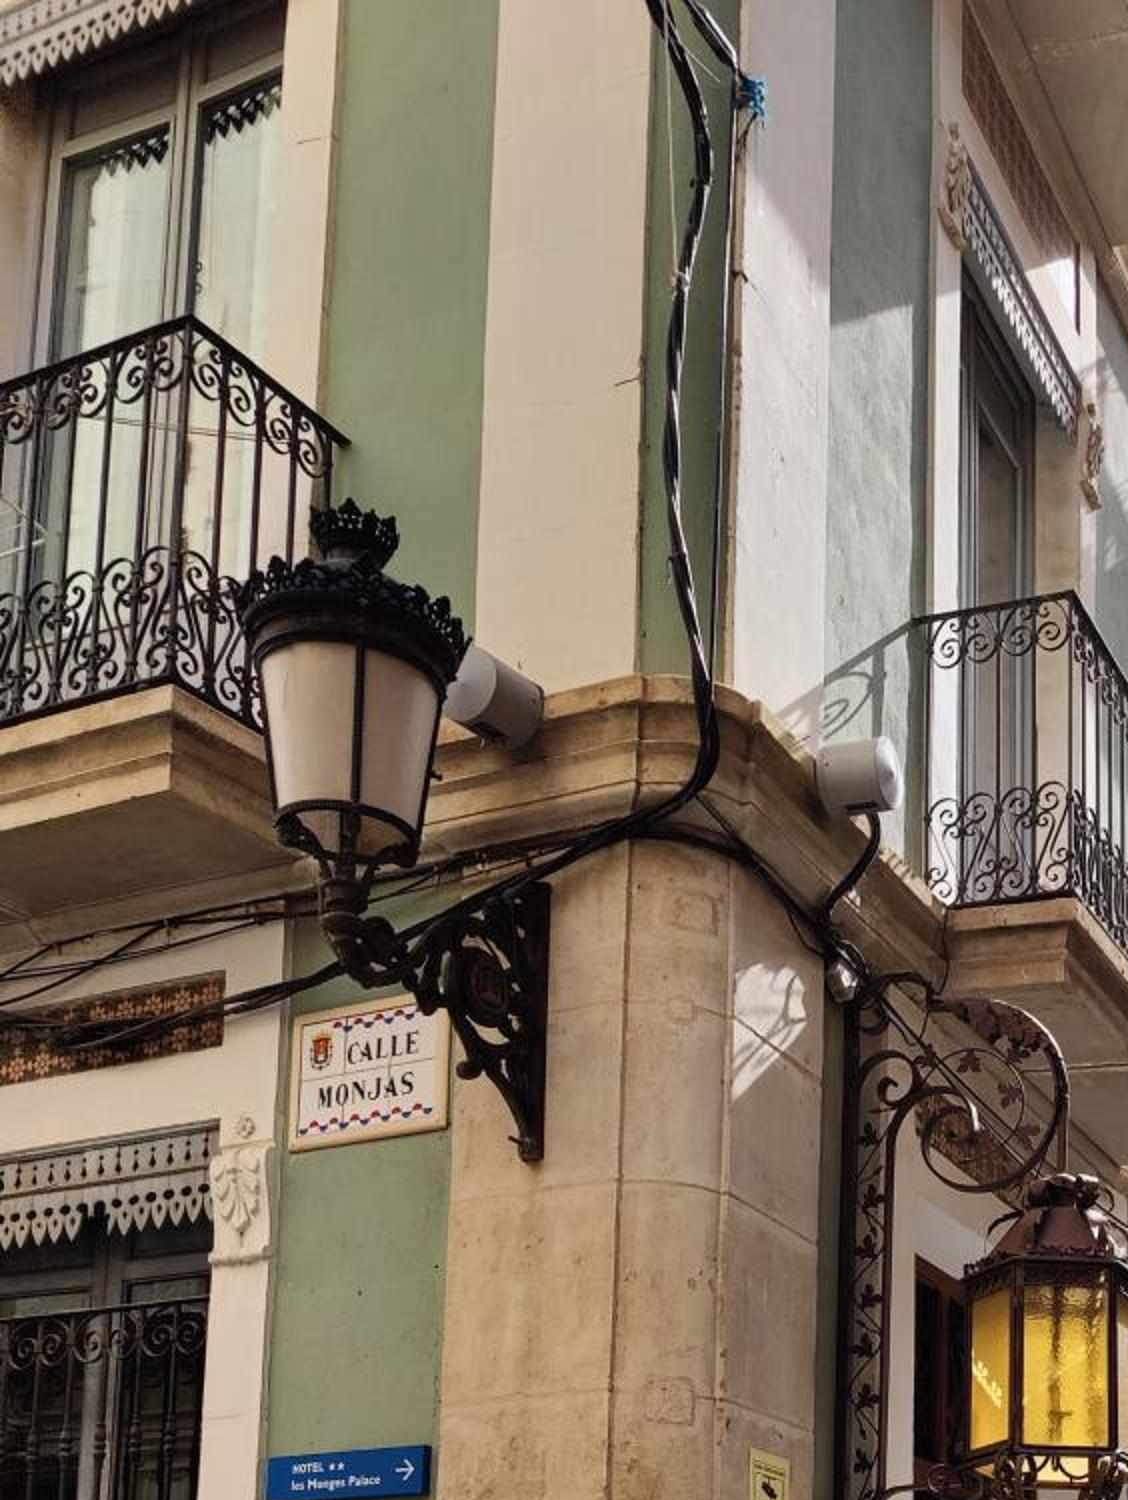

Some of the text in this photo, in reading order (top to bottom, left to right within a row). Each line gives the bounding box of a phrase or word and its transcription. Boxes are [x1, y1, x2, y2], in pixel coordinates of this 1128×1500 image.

[347, 1030, 419, 1065] CALLE
[318, 1071, 415, 1109] MONJAS
[291, 1462, 324, 1474] HOTEL
[307, 1477, 345, 1491] Monges
[348, 1475, 381, 1487] Palace
